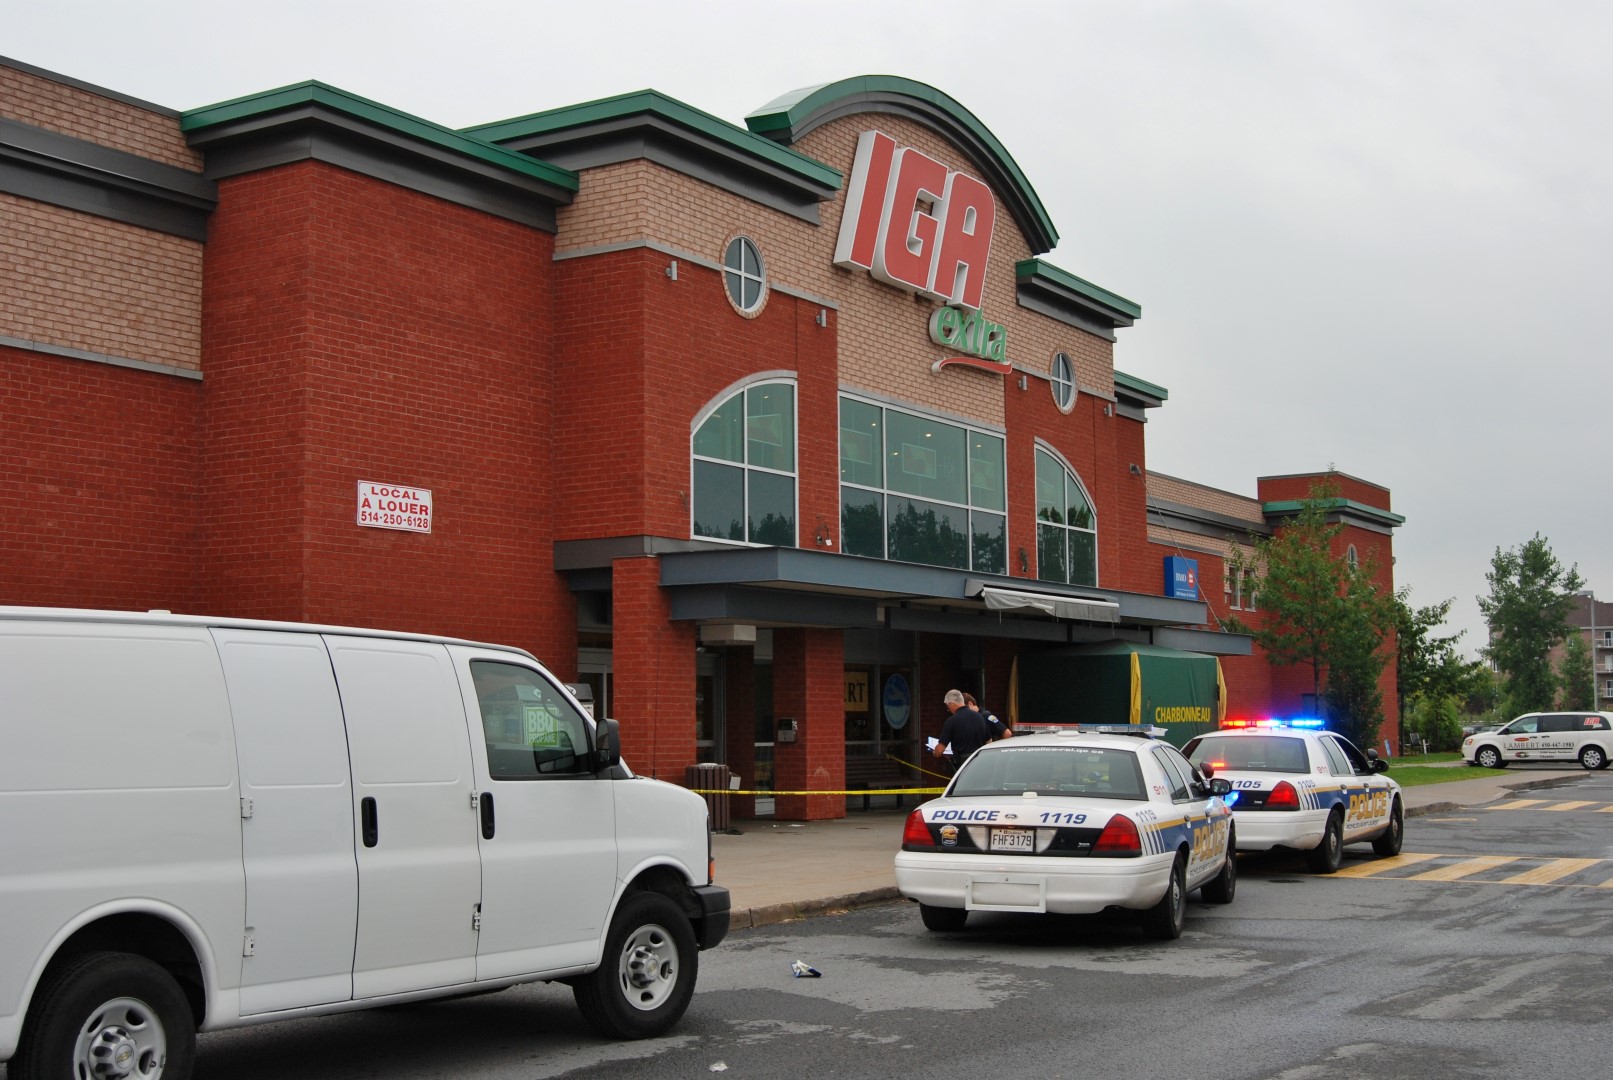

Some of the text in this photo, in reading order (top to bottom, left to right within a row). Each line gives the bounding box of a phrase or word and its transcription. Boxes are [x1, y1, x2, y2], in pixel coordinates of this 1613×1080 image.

[834, 130, 995, 310] IGA
[929, 306, 1007, 362] extra
[371, 486, 420, 500] LOCAL
[378, 499, 429, 515] LOUER
[361, 511, 428, 528] 514-250-6128
[844, 682, 865, 702] RT
[1155, 706, 1211, 723] CHARBONNEAU
[1152, 785, 1168, 796] 911
[1297, 780, 1316, 788] 1105
[1347, 791, 1387, 821] POLICE
[931, 810, 1087, 825] POLICE 1119
[1135, 809, 1158, 823] 1119
[992, 834, 1032, 847] FHF3179
[1190, 818, 1227, 864] POLICE
